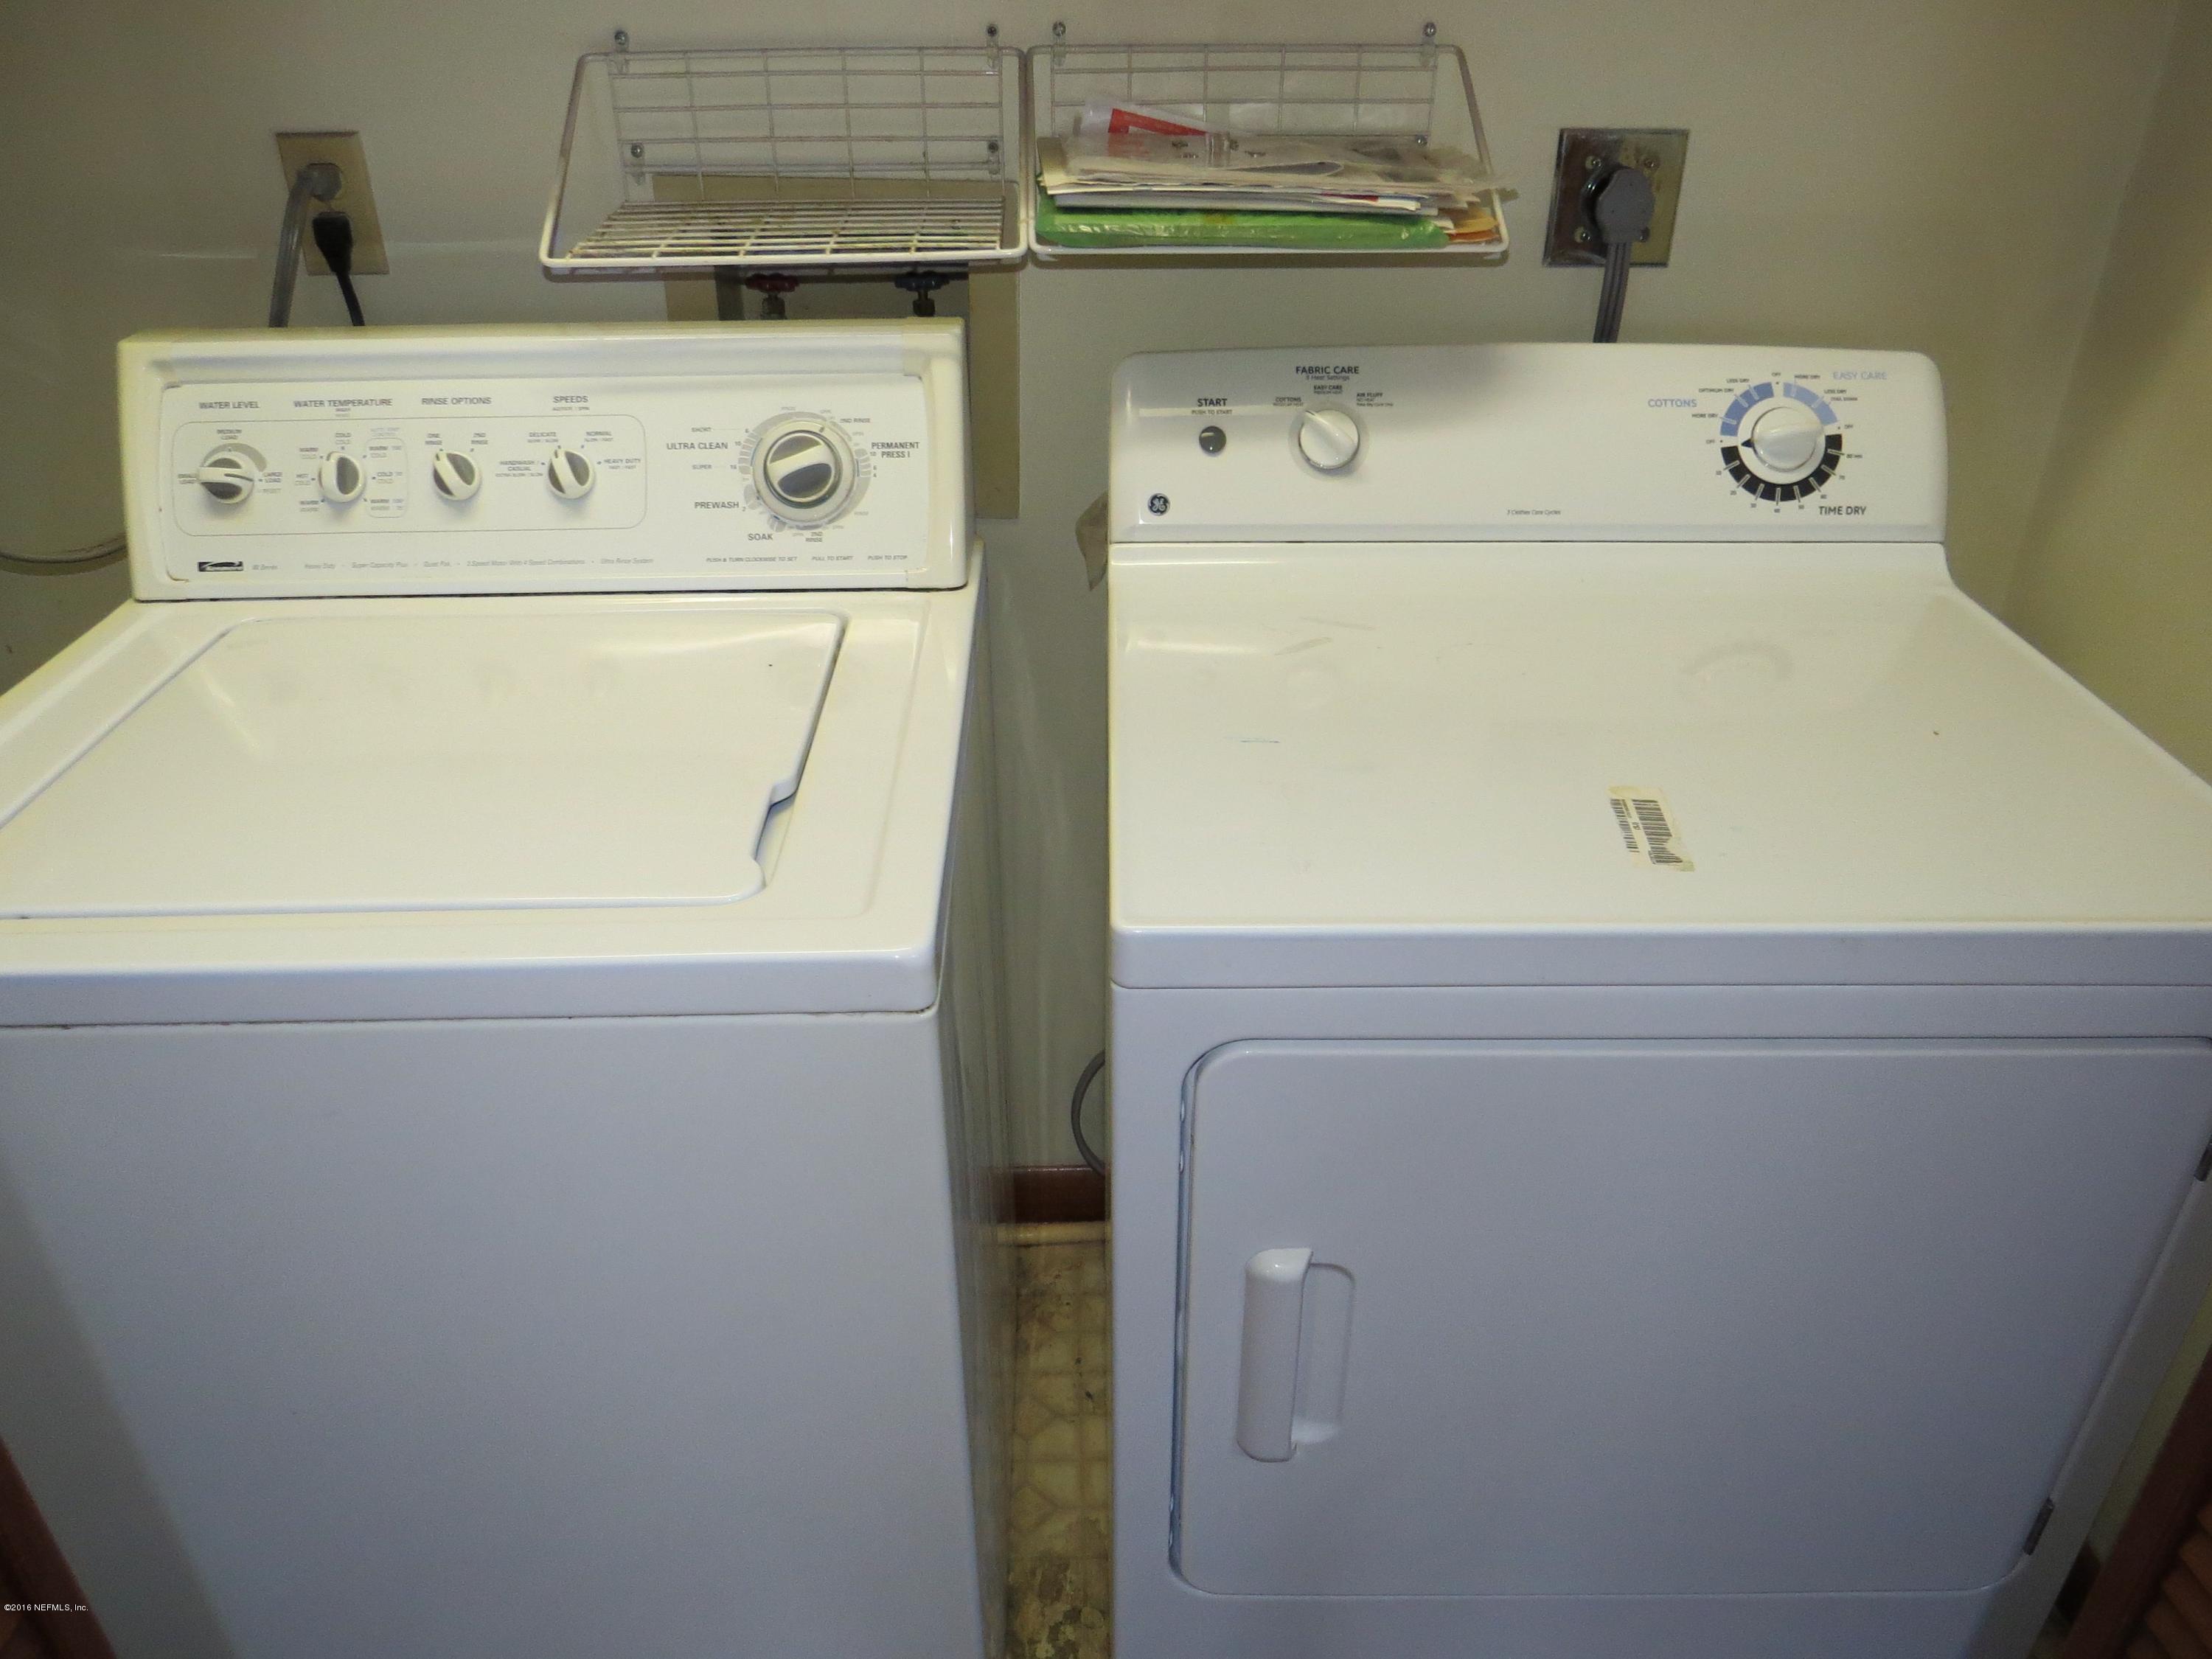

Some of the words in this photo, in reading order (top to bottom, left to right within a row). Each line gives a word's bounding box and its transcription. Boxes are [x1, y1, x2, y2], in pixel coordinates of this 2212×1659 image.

[1295, 366, 1330, 375] FABRIC
[1334, 366, 1360, 375] CARE
[1833, 372, 1857, 380] EASY
[1861, 372, 1888, 380] CARE
[328, 399, 393, 407] TEMPERATURE
[422, 397, 448, 406] RINSE
[451, 397, 492, 405] OPTIONS
[553, 396, 588, 404] SPEEDS
[1197, 398, 1228, 406] START
[1648, 399, 1697, 408] COTTONS
[698, 442, 728, 451] CLEAN
[695, 501, 740, 509] PREWASH
[1819, 507, 1844, 515] TIME
[1846, 507, 1867, 515] DRY
[748, 533, 773, 542] SOAK
